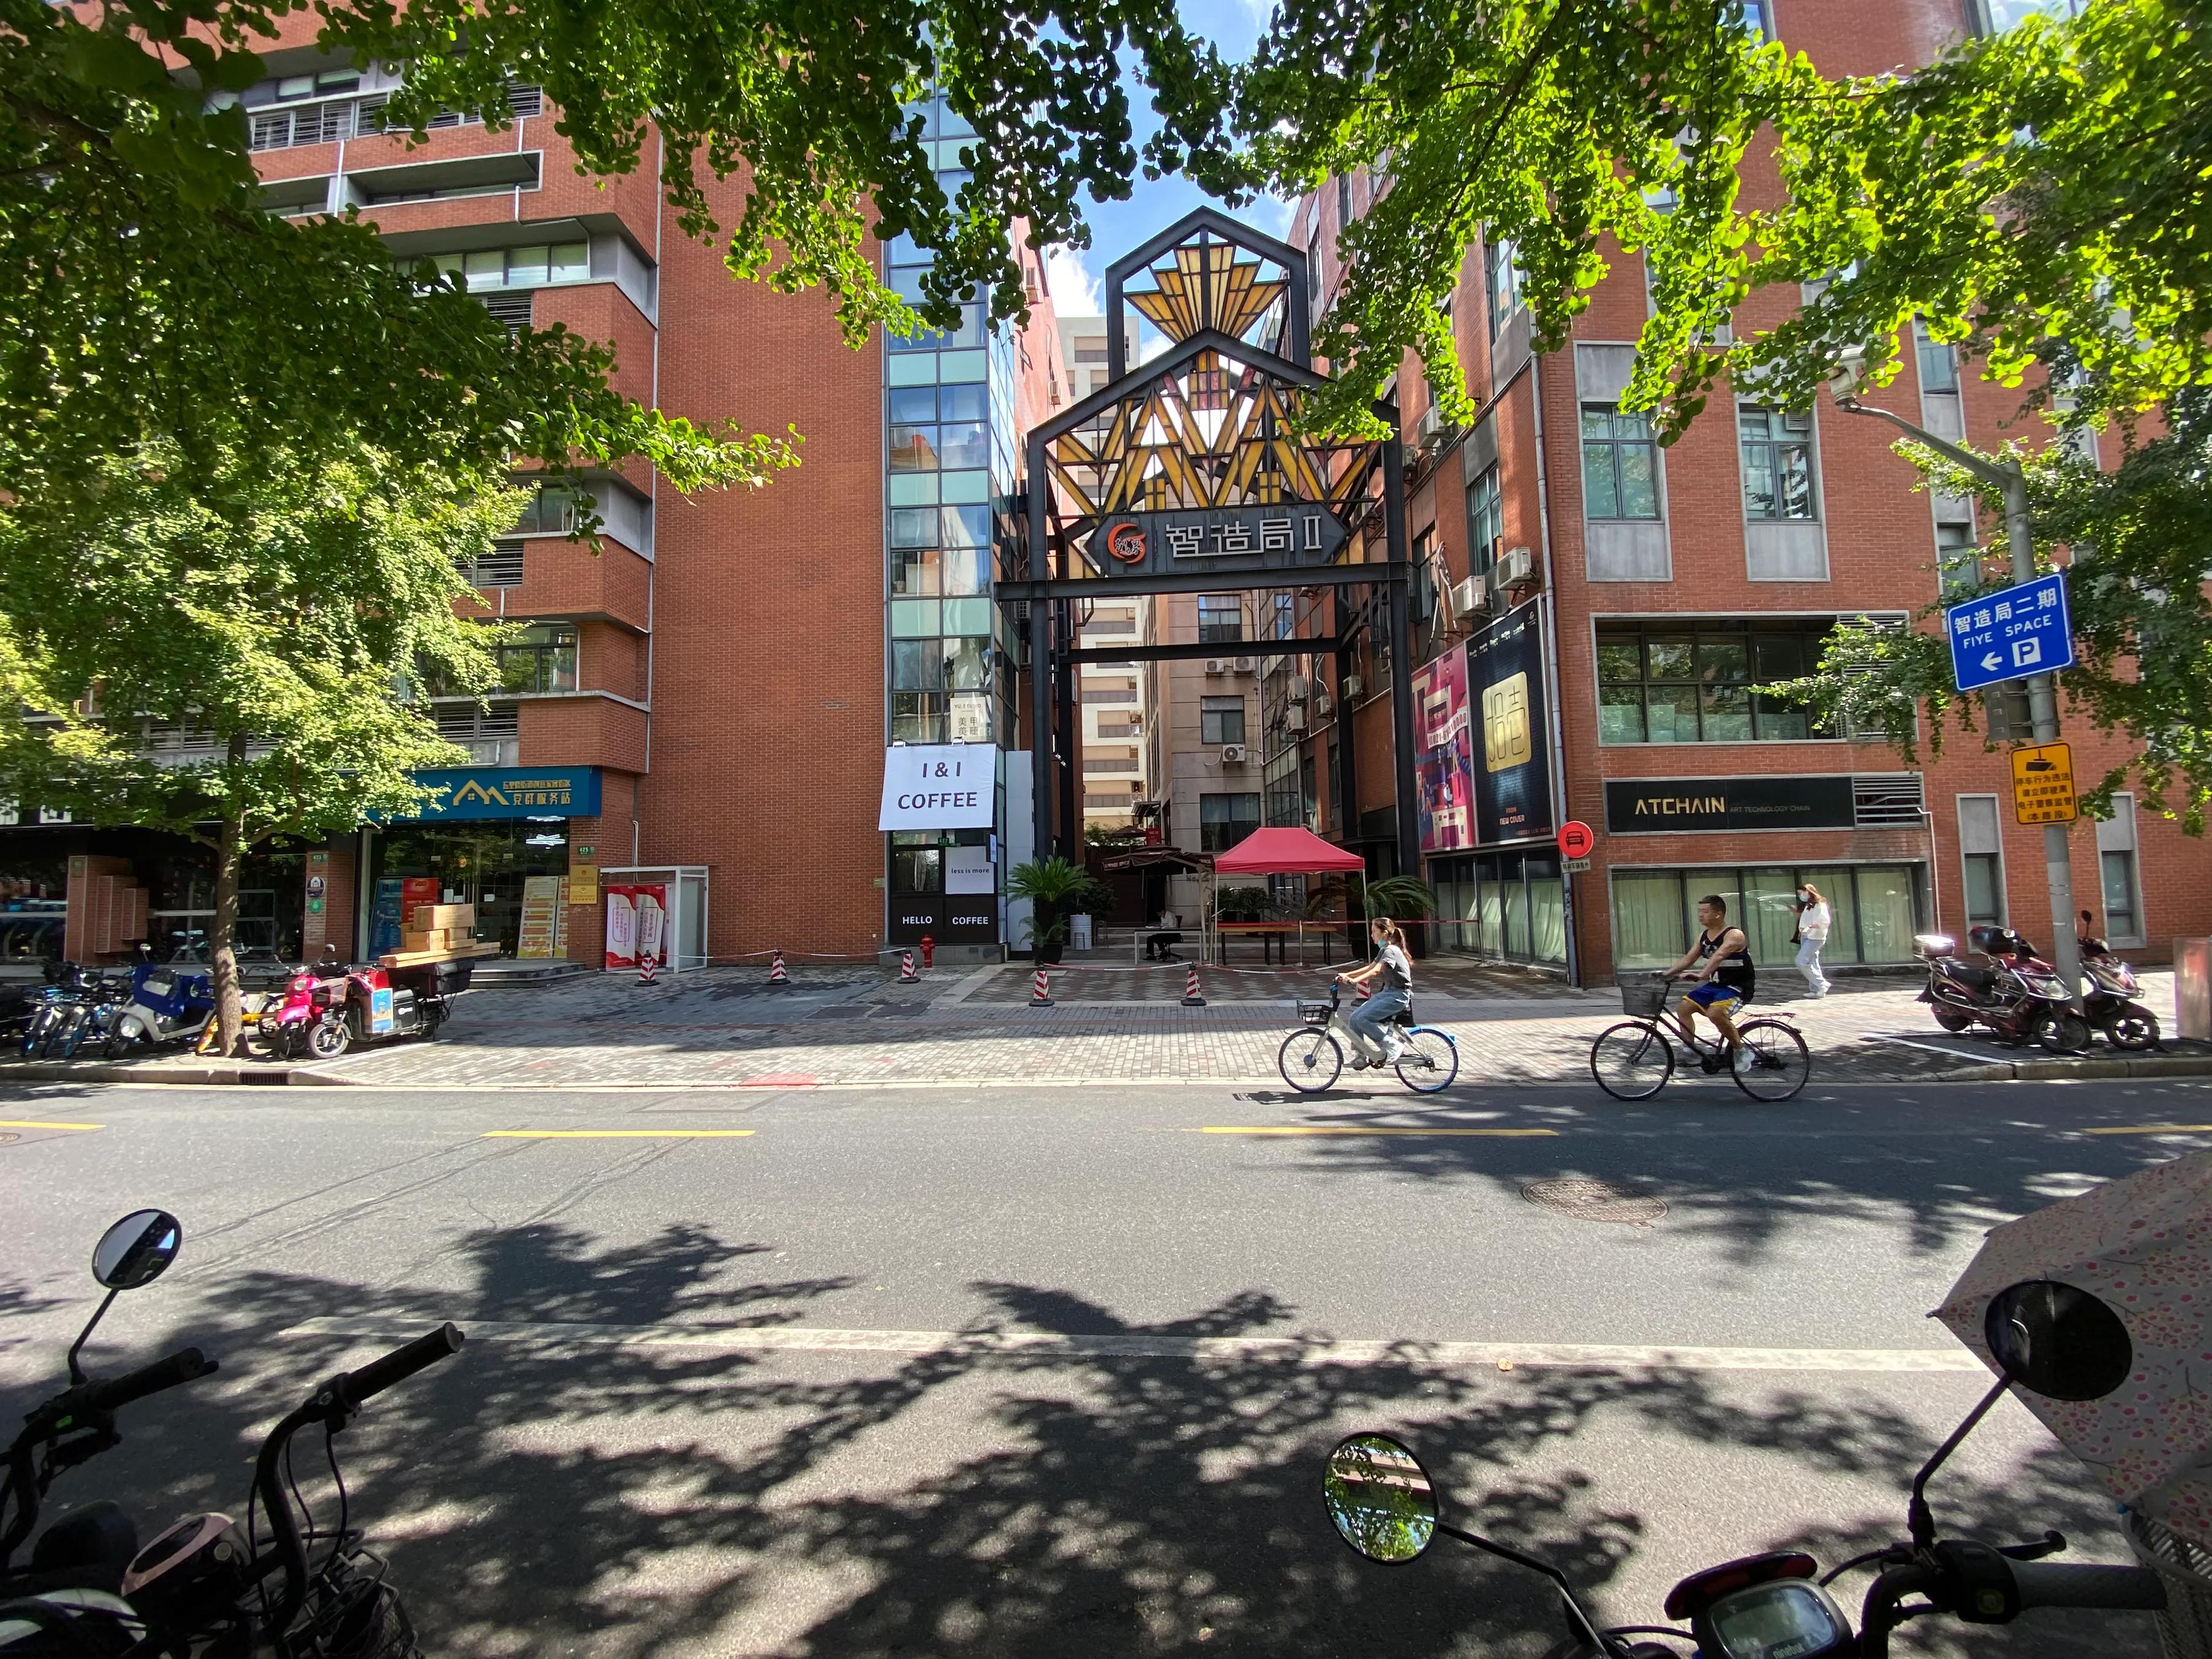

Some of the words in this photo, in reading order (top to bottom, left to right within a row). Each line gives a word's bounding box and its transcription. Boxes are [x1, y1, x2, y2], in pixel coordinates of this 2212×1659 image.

[1954, 587, 2057, 635] 智造局二期
[1963, 632, 1993, 649] FIYE
[2005, 614, 2052, 637] SPACE
[2018, 641, 2035, 664] P
[958, 716, 978, 726] 美甲
[934, 762, 949, 777] &
[2015, 773, 2070, 786] 停车行为违法
[512, 791, 571, 806] 党群服务站
[897, 791, 978, 810] COFFEE
[1634, 796, 1725, 815] ATCHAIN
[902, 916, 933, 925] HELLO
[952, 916, 989, 925] COFFEE
